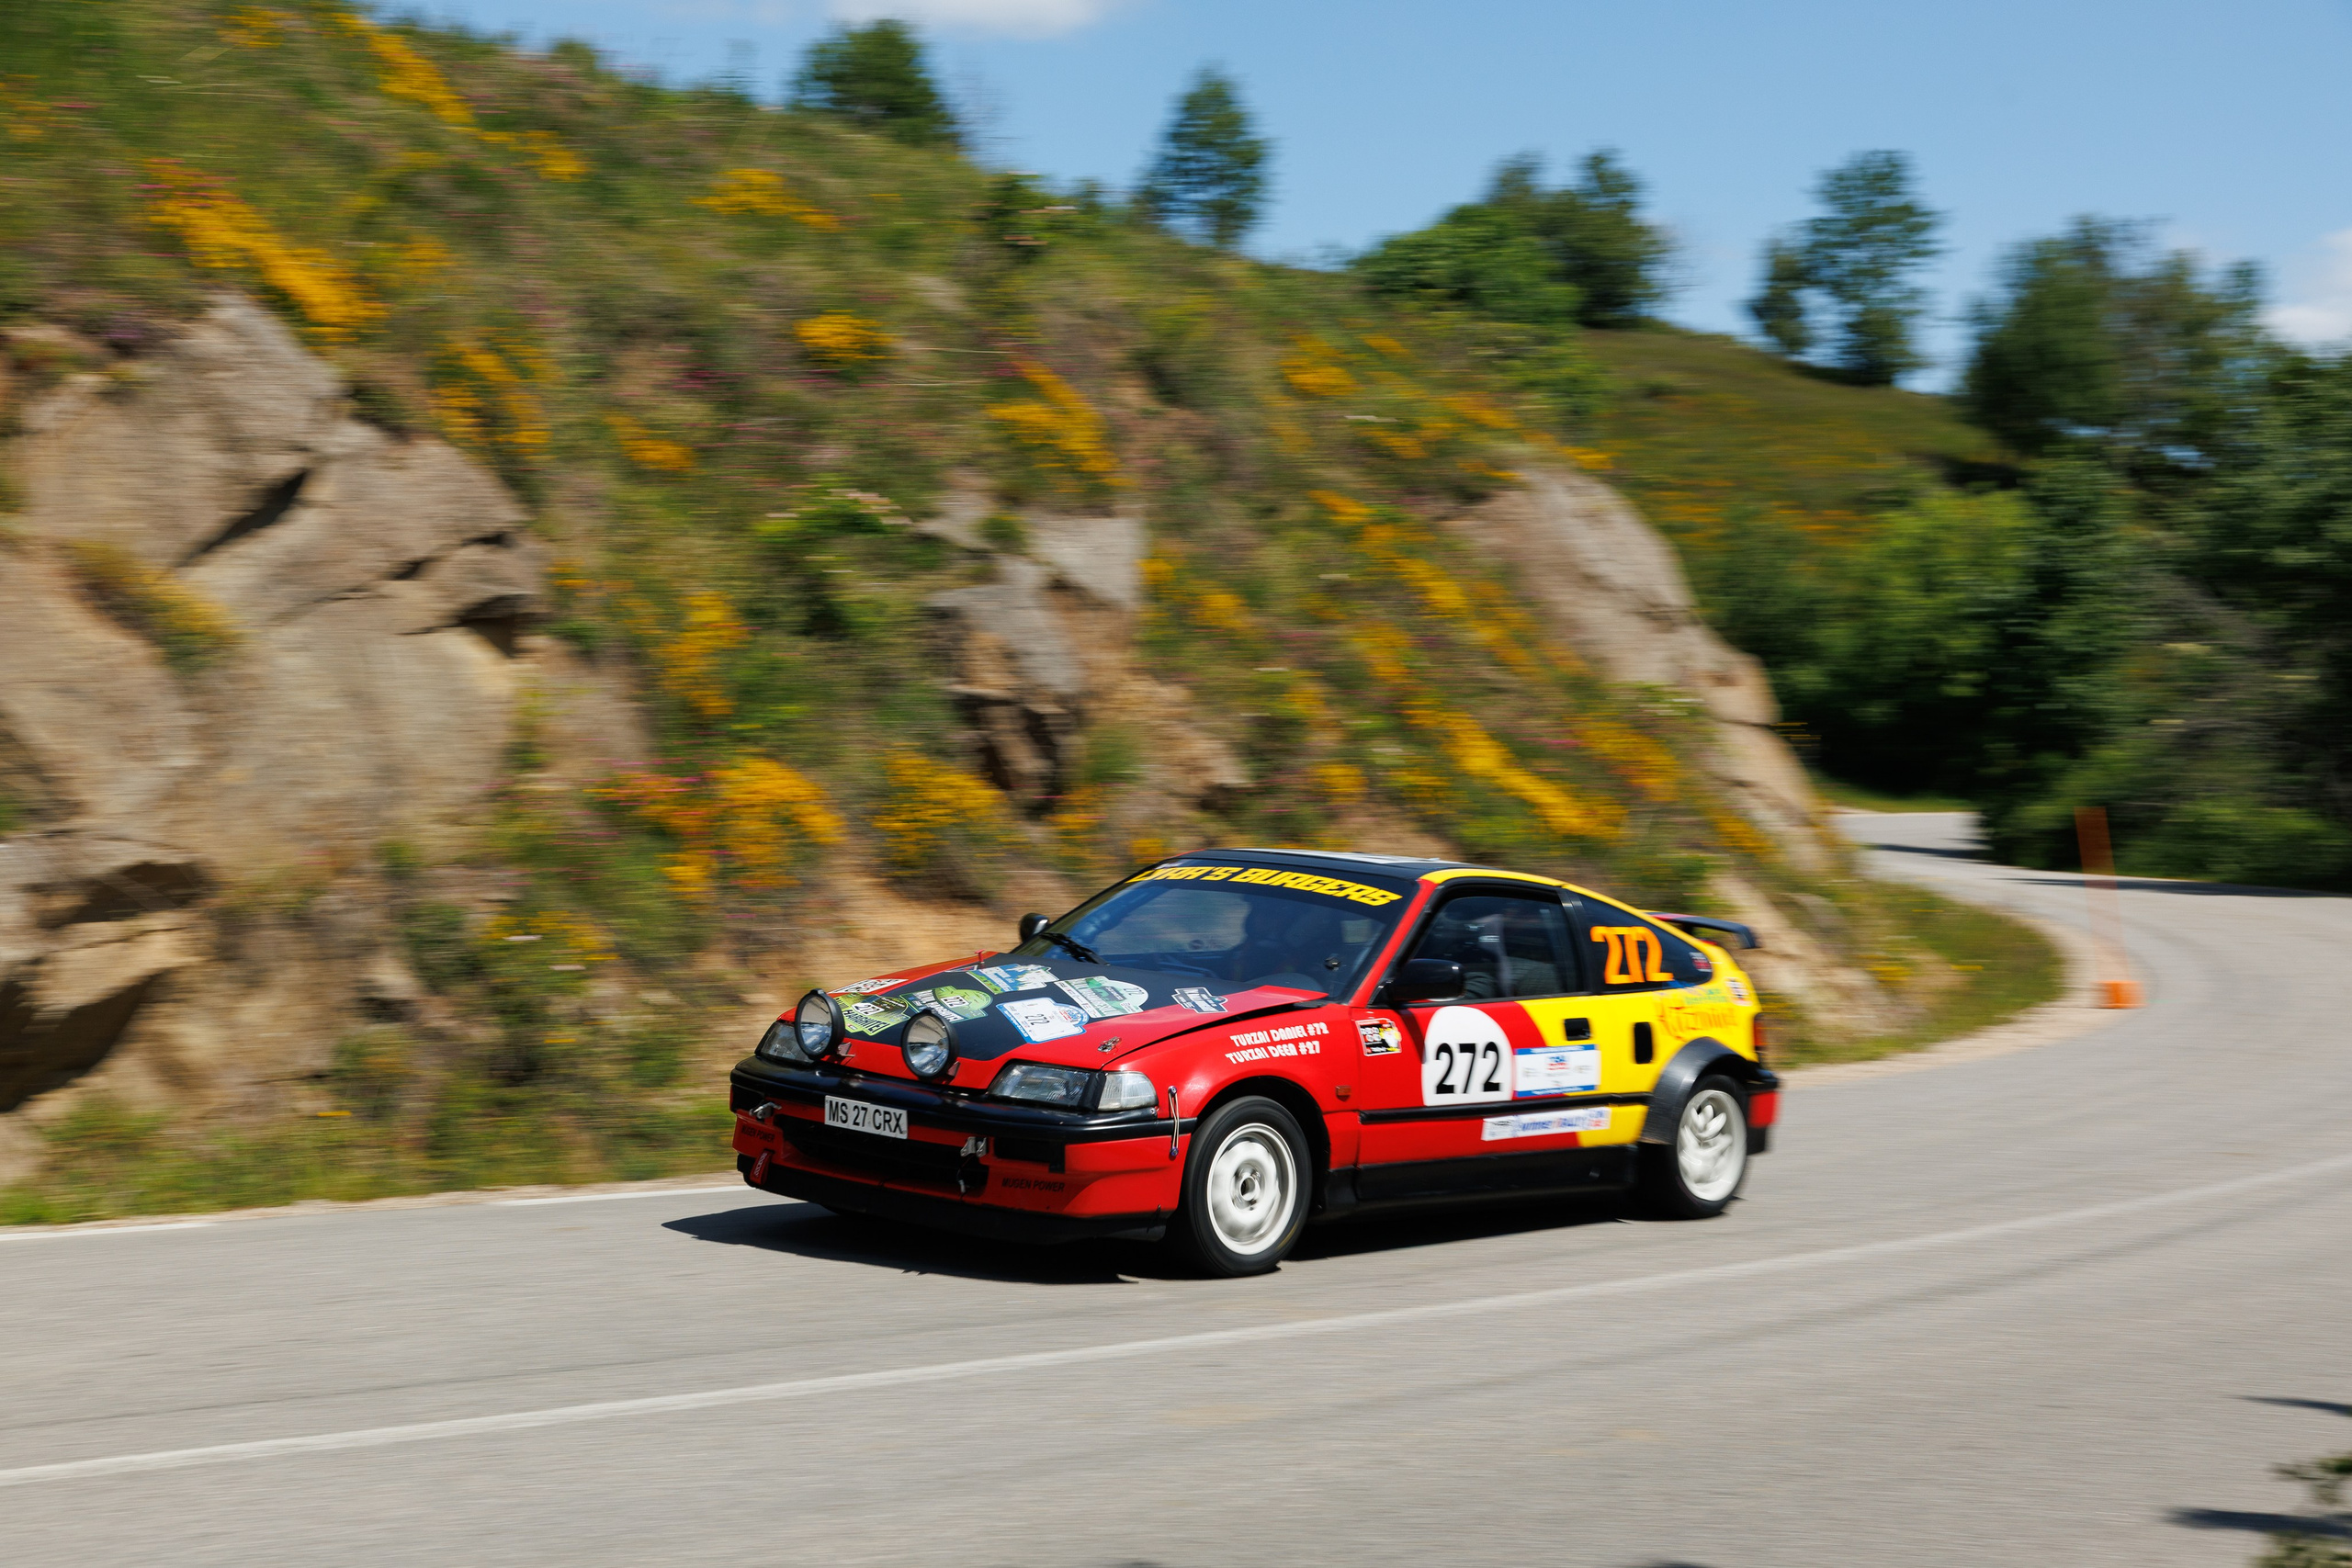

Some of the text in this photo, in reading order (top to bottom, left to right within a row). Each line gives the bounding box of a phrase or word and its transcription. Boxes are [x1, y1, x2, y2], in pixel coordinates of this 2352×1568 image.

[1125, 866, 1403, 907] LYRA'S BURGERS
[1590, 926, 1674, 985] 272
[943, 996, 967, 1008] 272
[1123, 987, 1145, 996] 272
[842, 1009, 890, 1032] HARGHITEI
[854, 1003, 880, 1015] 272
[1024, 1013, 1050, 1026] 272
[1229, 1021, 1330, 1047] TURZAI DANIEL #72
[1225, 1047, 1270, 1065] TURZAI
[1298, 1040, 1321, 1055] #27
[1435, 1041, 1501, 1095] 272
[829, 1100, 904, 1134] MS 27 CRX
[1001, 1177, 1066, 1193] MUGEN POWER
